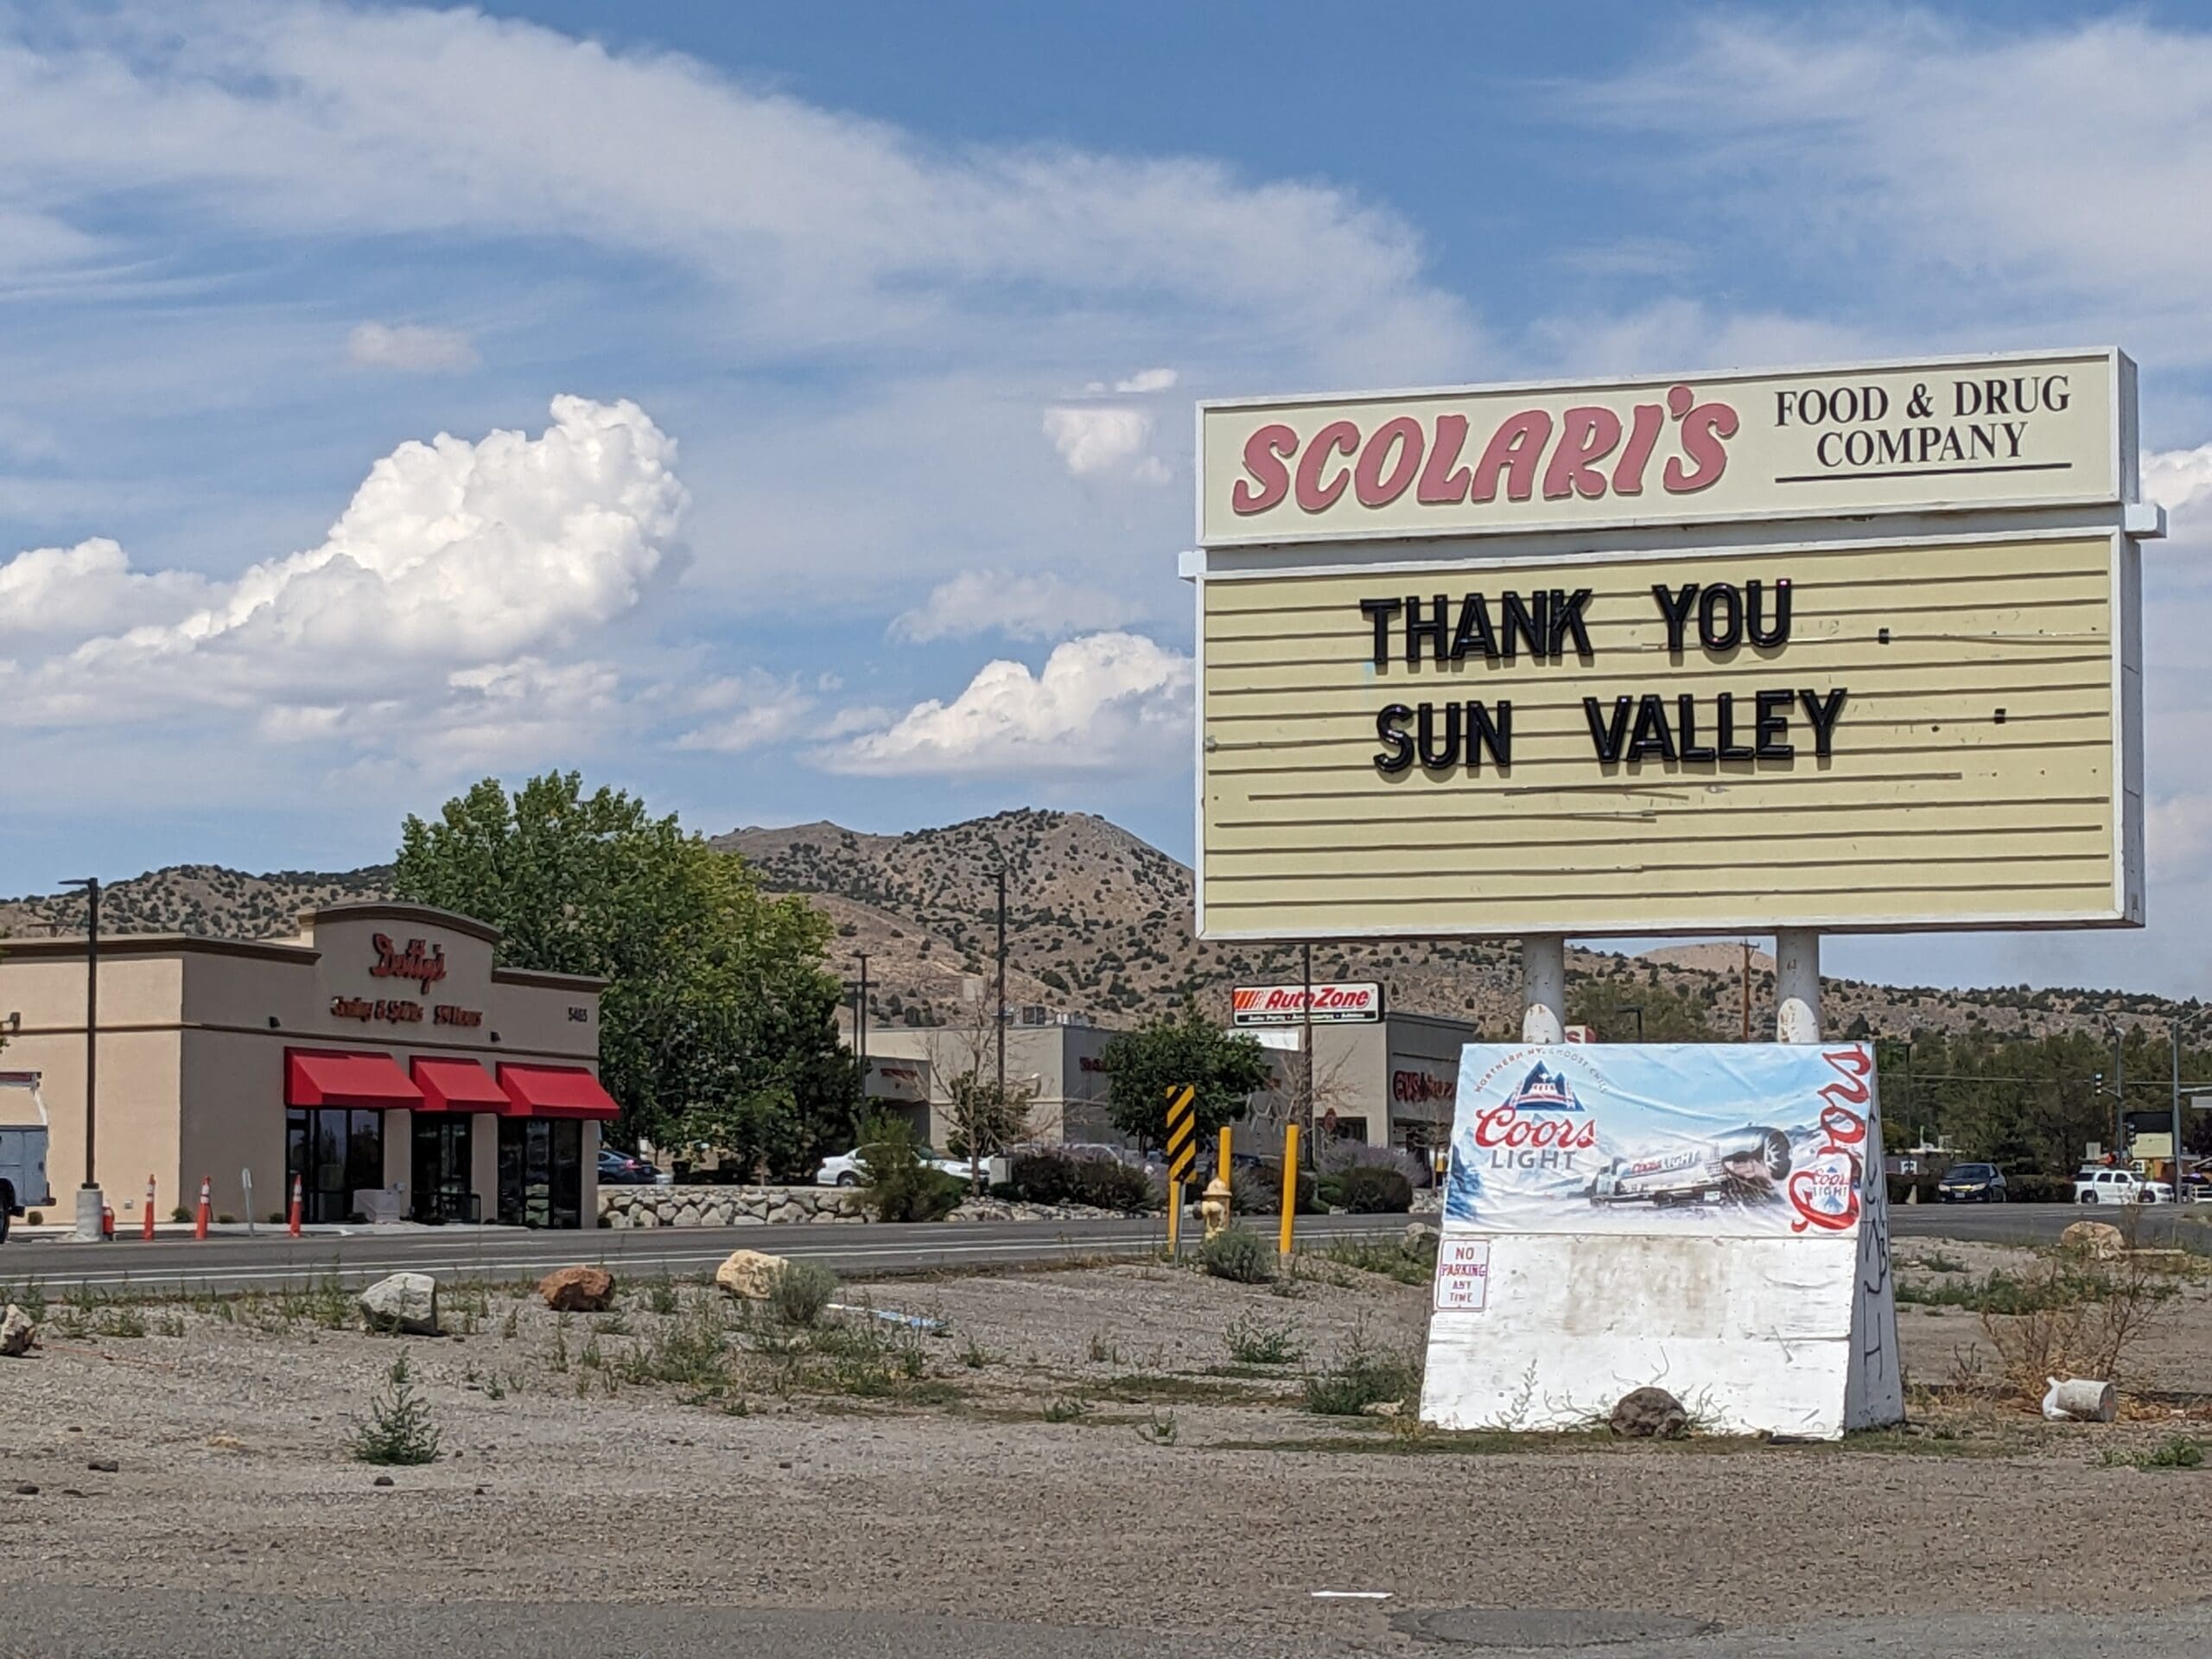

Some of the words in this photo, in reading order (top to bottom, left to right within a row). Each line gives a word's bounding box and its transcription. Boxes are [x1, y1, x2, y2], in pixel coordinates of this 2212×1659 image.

[1775, 387, 1889, 428] FOOD
[1905, 383, 1936, 419] &
[1953, 375, 2071, 416] DRUG
[1231, 385, 1739, 516] SCOLARI'S
[1817, 421, 2029, 467] COMPANY
[1360, 588, 1593, 666] THANK
[1652, 578, 1792, 653] YOU
[1374, 700, 1512, 772] SUN
[1583, 687, 1848, 763] VALLEY
[1265, 987, 1370, 1009] AutoZone
[1475, 1103, 1597, 1148] Coors
[1491, 1149, 1577, 1169] LIGHT
[1440, 1263, 1486, 1276] PARKING
[1455, 1247, 1475, 1260] NO
[1450, 1292, 1473, 1303] TIME
[1452, 1281, 1472, 1290] ANY
